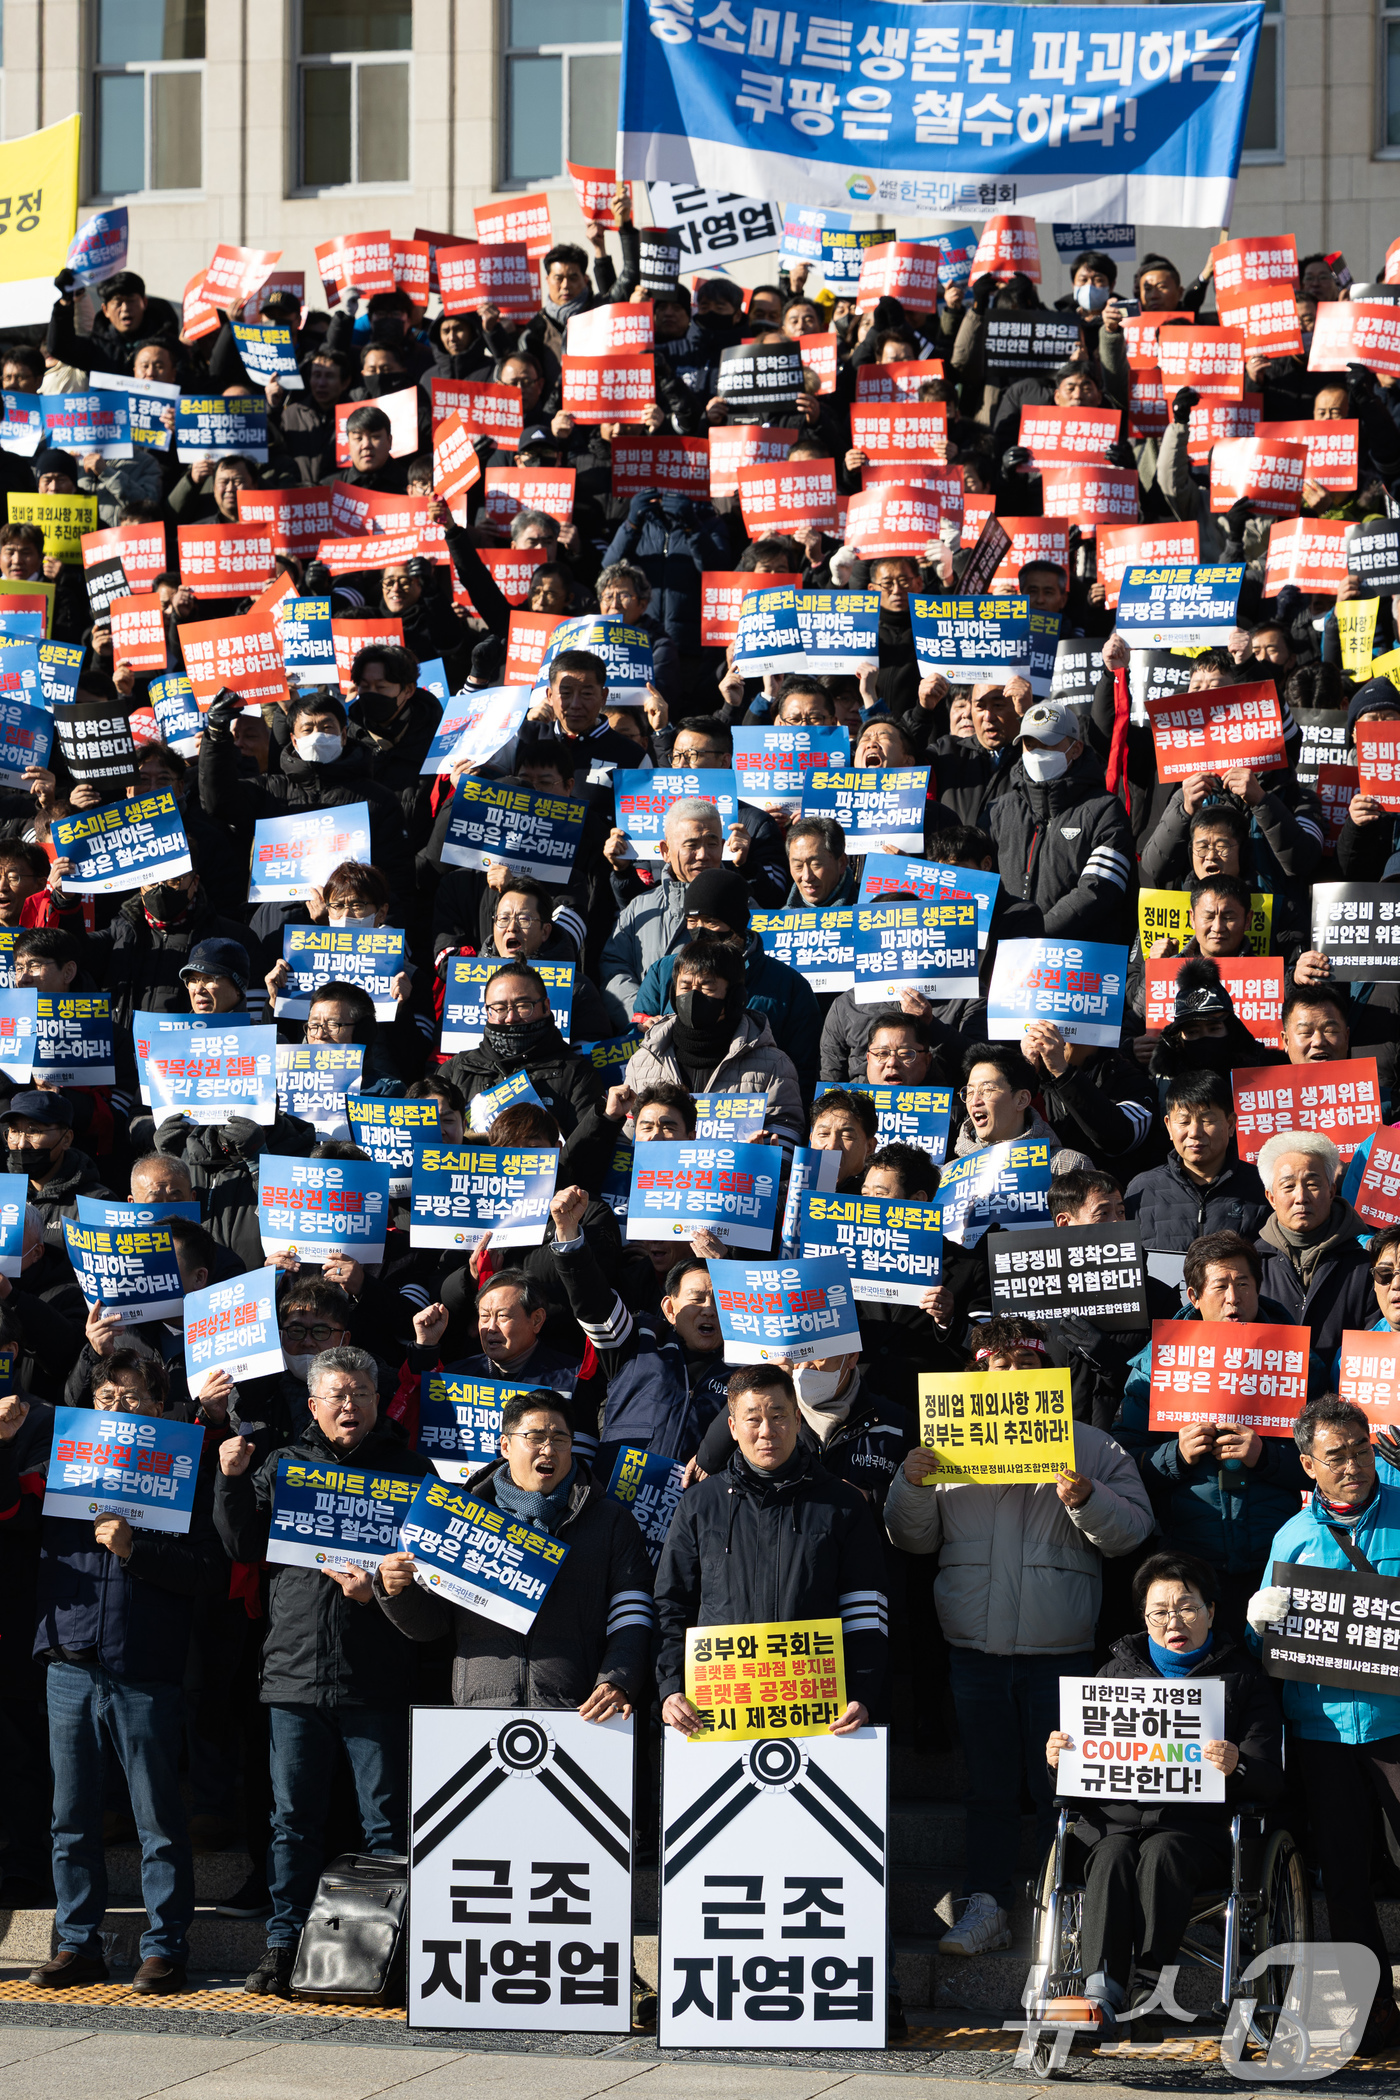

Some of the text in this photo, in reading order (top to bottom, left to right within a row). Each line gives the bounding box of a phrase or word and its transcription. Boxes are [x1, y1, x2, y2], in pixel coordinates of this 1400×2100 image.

[649, 0, 1240, 87] 중소마트생존권 파괴하는
[735, 68, 1139, 148] 쿠팡은 철수하라!
[900, 181, 1017, 205] 한국마트협회
[564, 369, 652, 384] 정비업 생계위협
[563, 385, 655, 400] 쿠팡은 각성하라!
[180, 400, 265, 414] 중소마트 생존권
[198, 415, 245, 428] 파괴하는
[854, 418, 944, 433] 정비업 생계위협
[1023, 420, 1116, 438] 정비업 생계위협
[178, 427, 266, 444] 쿠팡은 철수하라!
[853, 433, 890, 449] 쿠팡은
[741, 475, 832, 496] 정비업 생계위협
[11, 506, 33, 521] 정비업
[75, 507, 92, 523] 개정
[742, 492, 836, 513] 쿠팡은 각성하라!
[181, 538, 271, 556] 정비업 생계위협
[181, 556, 275, 574] 쿠팡은 각성하라!
[1129, 567, 1242, 585] 중소마트 생존권
[1149, 585, 1212, 601] 파괴하는
[913, 600, 1028, 619] 중소마트 생존권
[1119, 601, 1235, 622] 쿠팡은 철수하라!
[937, 620, 1001, 638] 파괴하는
[916, 636, 1028, 658] 쿠팡은 철수하라!
[74, 717, 126, 738] 정착으로
[1154, 700, 1276, 729] 정비업 생계위협
[77, 738, 133, 759] 위협한다!
[1156, 721, 1282, 750] 쿠팡은 각성하라!
[1163, 754, 1281, 775] 한국자동차전문정비사업조합연합회
[58, 793, 176, 844] 중소마트 생존권
[87, 822, 155, 855] 파괴하는
[116, 832, 186, 869] 철수하라!
[858, 905, 974, 931] 중소마트 생존권
[881, 928, 946, 949] 파괴하는
[855, 948, 975, 973] 쿠팡은 철수하라!
[1238, 1080, 1374, 1112] 정비업 생계위협
[1238, 1105, 1380, 1135] 쿠팡은 각성하라!
[421, 1149, 556, 1176] 중소마트 생존권
[678, 1148, 735, 1169] 쿠팡은
[291, 1166, 344, 1188] 쿠팡은
[451, 1174, 525, 1198] 파괴하는
[637, 1169, 772, 1198] 골목상권 침탈을
[262, 1186, 383, 1213] 골목상권 침탈을
[414, 1195, 548, 1220] 쿠팡은 철수하라!
[644, 1191, 762, 1217] 즉각 중단하라
[268, 1210, 372, 1235] 즉각 중단하라
[809, 1198, 941, 1232] 중소마트 생존권
[837, 1224, 909, 1251] 파괴하는
[861, 1248, 940, 1276] 철수하라!
[994, 1242, 1137, 1274] 불량정비 정착으로
[745, 1268, 800, 1291] 쿠팡은
[994, 1269, 1142, 1299] 국민안전 위협한다!
[208, 1283, 245, 1310] 쿠팡은
[718, 1284, 848, 1314] 골목상권 침탈을
[188, 1297, 272, 1344] 골목상권 침탈을
[730, 1308, 840, 1338] 즉각 중단하라
[191, 1322, 267, 1363] 즉각 중단하라
[1157, 1345, 1304, 1373] 정비업 생계위협
[1345, 1356, 1396, 1379] 정비업
[1153, 1369, 1305, 1398] 쿠팡은 각성하라!
[1341, 1381, 1391, 1405] 쿠팡은
[925, 1390, 1064, 1418] 정비업 제외사항 개정
[98, 1419, 156, 1448] 쿠팡은
[924, 1419, 1069, 1448] 정부는 즉시 추진하라!
[57, 1439, 193, 1478] 골목상권 침탈을
[63, 1464, 179, 1500] 즉각 중단하라
[285, 1466, 366, 1495] 중소마트
[614, 1448, 648, 1502] 생존권
[315, 1492, 395, 1524] 파괴하는
[274, 1509, 334, 1538] 쿠팡은
[425, 1483, 566, 1565] 중소마트 생존권
[445, 1517, 524, 1566] 파괴하는
[402, 1524, 547, 1601] 쿠팡은 철수하라!
[694, 1631, 834, 1662] 정부와 국회는
[694, 1657, 836, 1681] 플랫폼 독과점 방지법
[695, 1678, 838, 1706] 플랫폼 공정화법
[1082, 1685, 1202, 1705] 대한민국 자영업
[697, 1702, 838, 1731] 즉시 제정하라!
[1082, 1706, 1202, 1739] 말살하는
[1082, 1740, 1202, 1762] COUPANG
[1080, 1764, 1201, 1794] 규탄한다!
[450, 1859, 591, 1925] 근조
[702, 1875, 845, 1940] 근조
[421, 1939, 619, 2006] 자영업
[672, 1955, 874, 2022] 자영업
